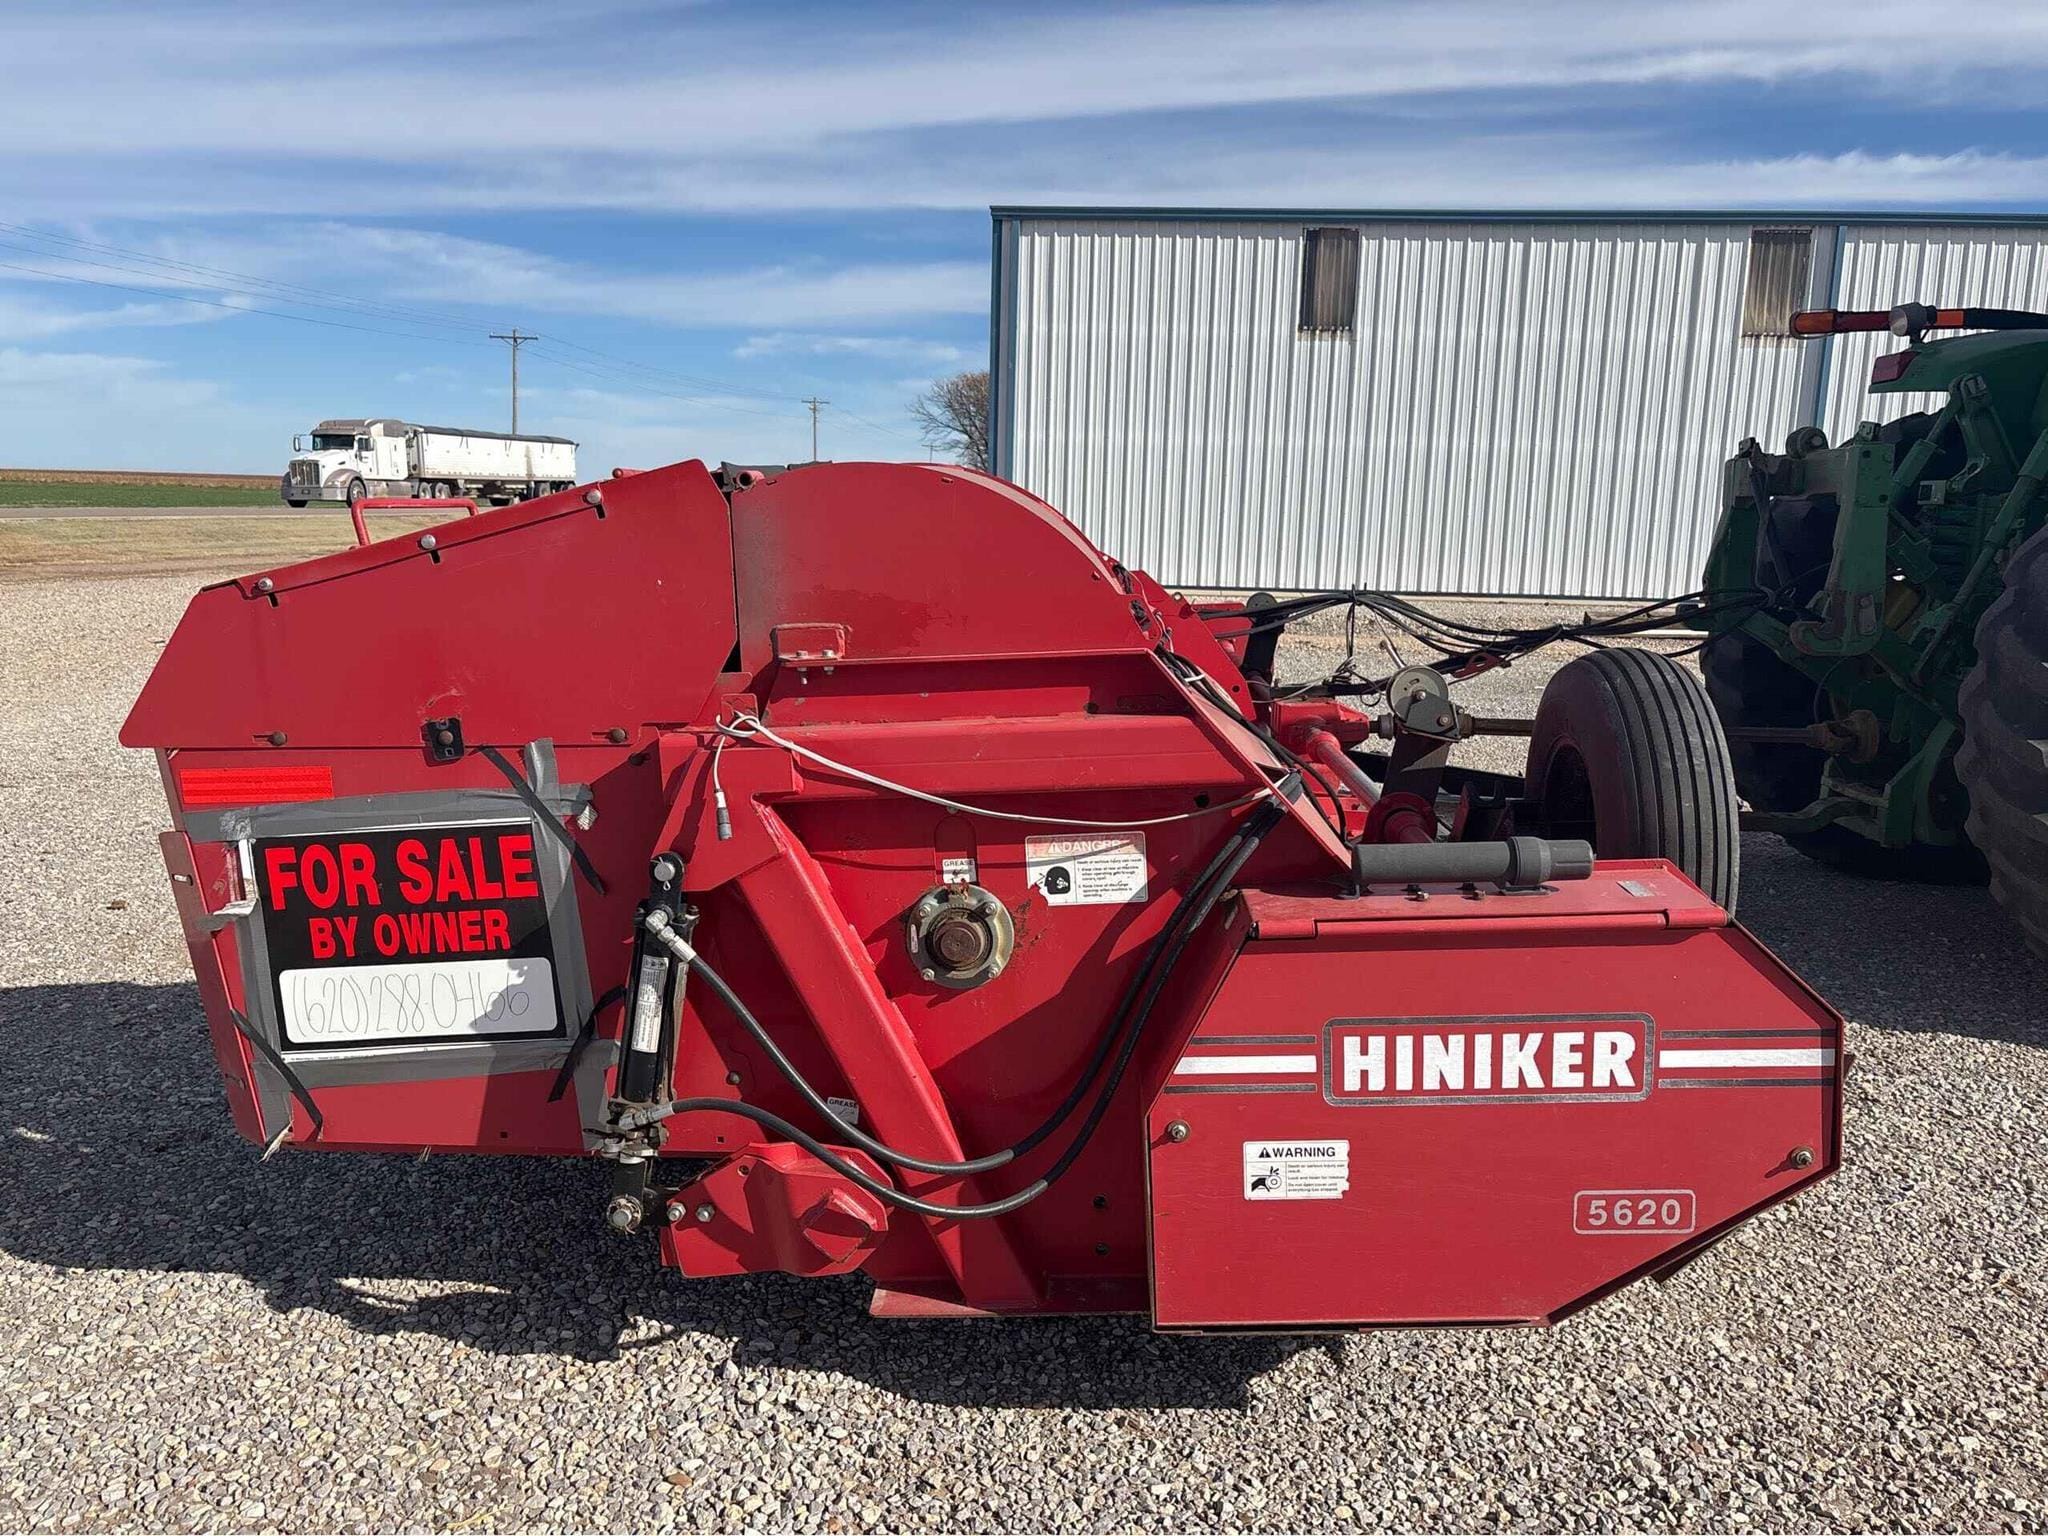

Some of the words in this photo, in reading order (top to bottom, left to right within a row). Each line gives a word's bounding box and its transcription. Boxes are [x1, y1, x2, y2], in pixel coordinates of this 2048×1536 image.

[265, 844, 381, 910] FOR
[396, 835, 538, 904] SALE
[309, 916, 358, 959] BY
[373, 909, 512, 956] OWNER
[1343, 1031, 1637, 1091] HINIKER
[829, 1098, 857, 1108] GREASE
[1272, 1147, 1335, 1157] WARNING
[1588, 1199, 1681, 1226] 5620
